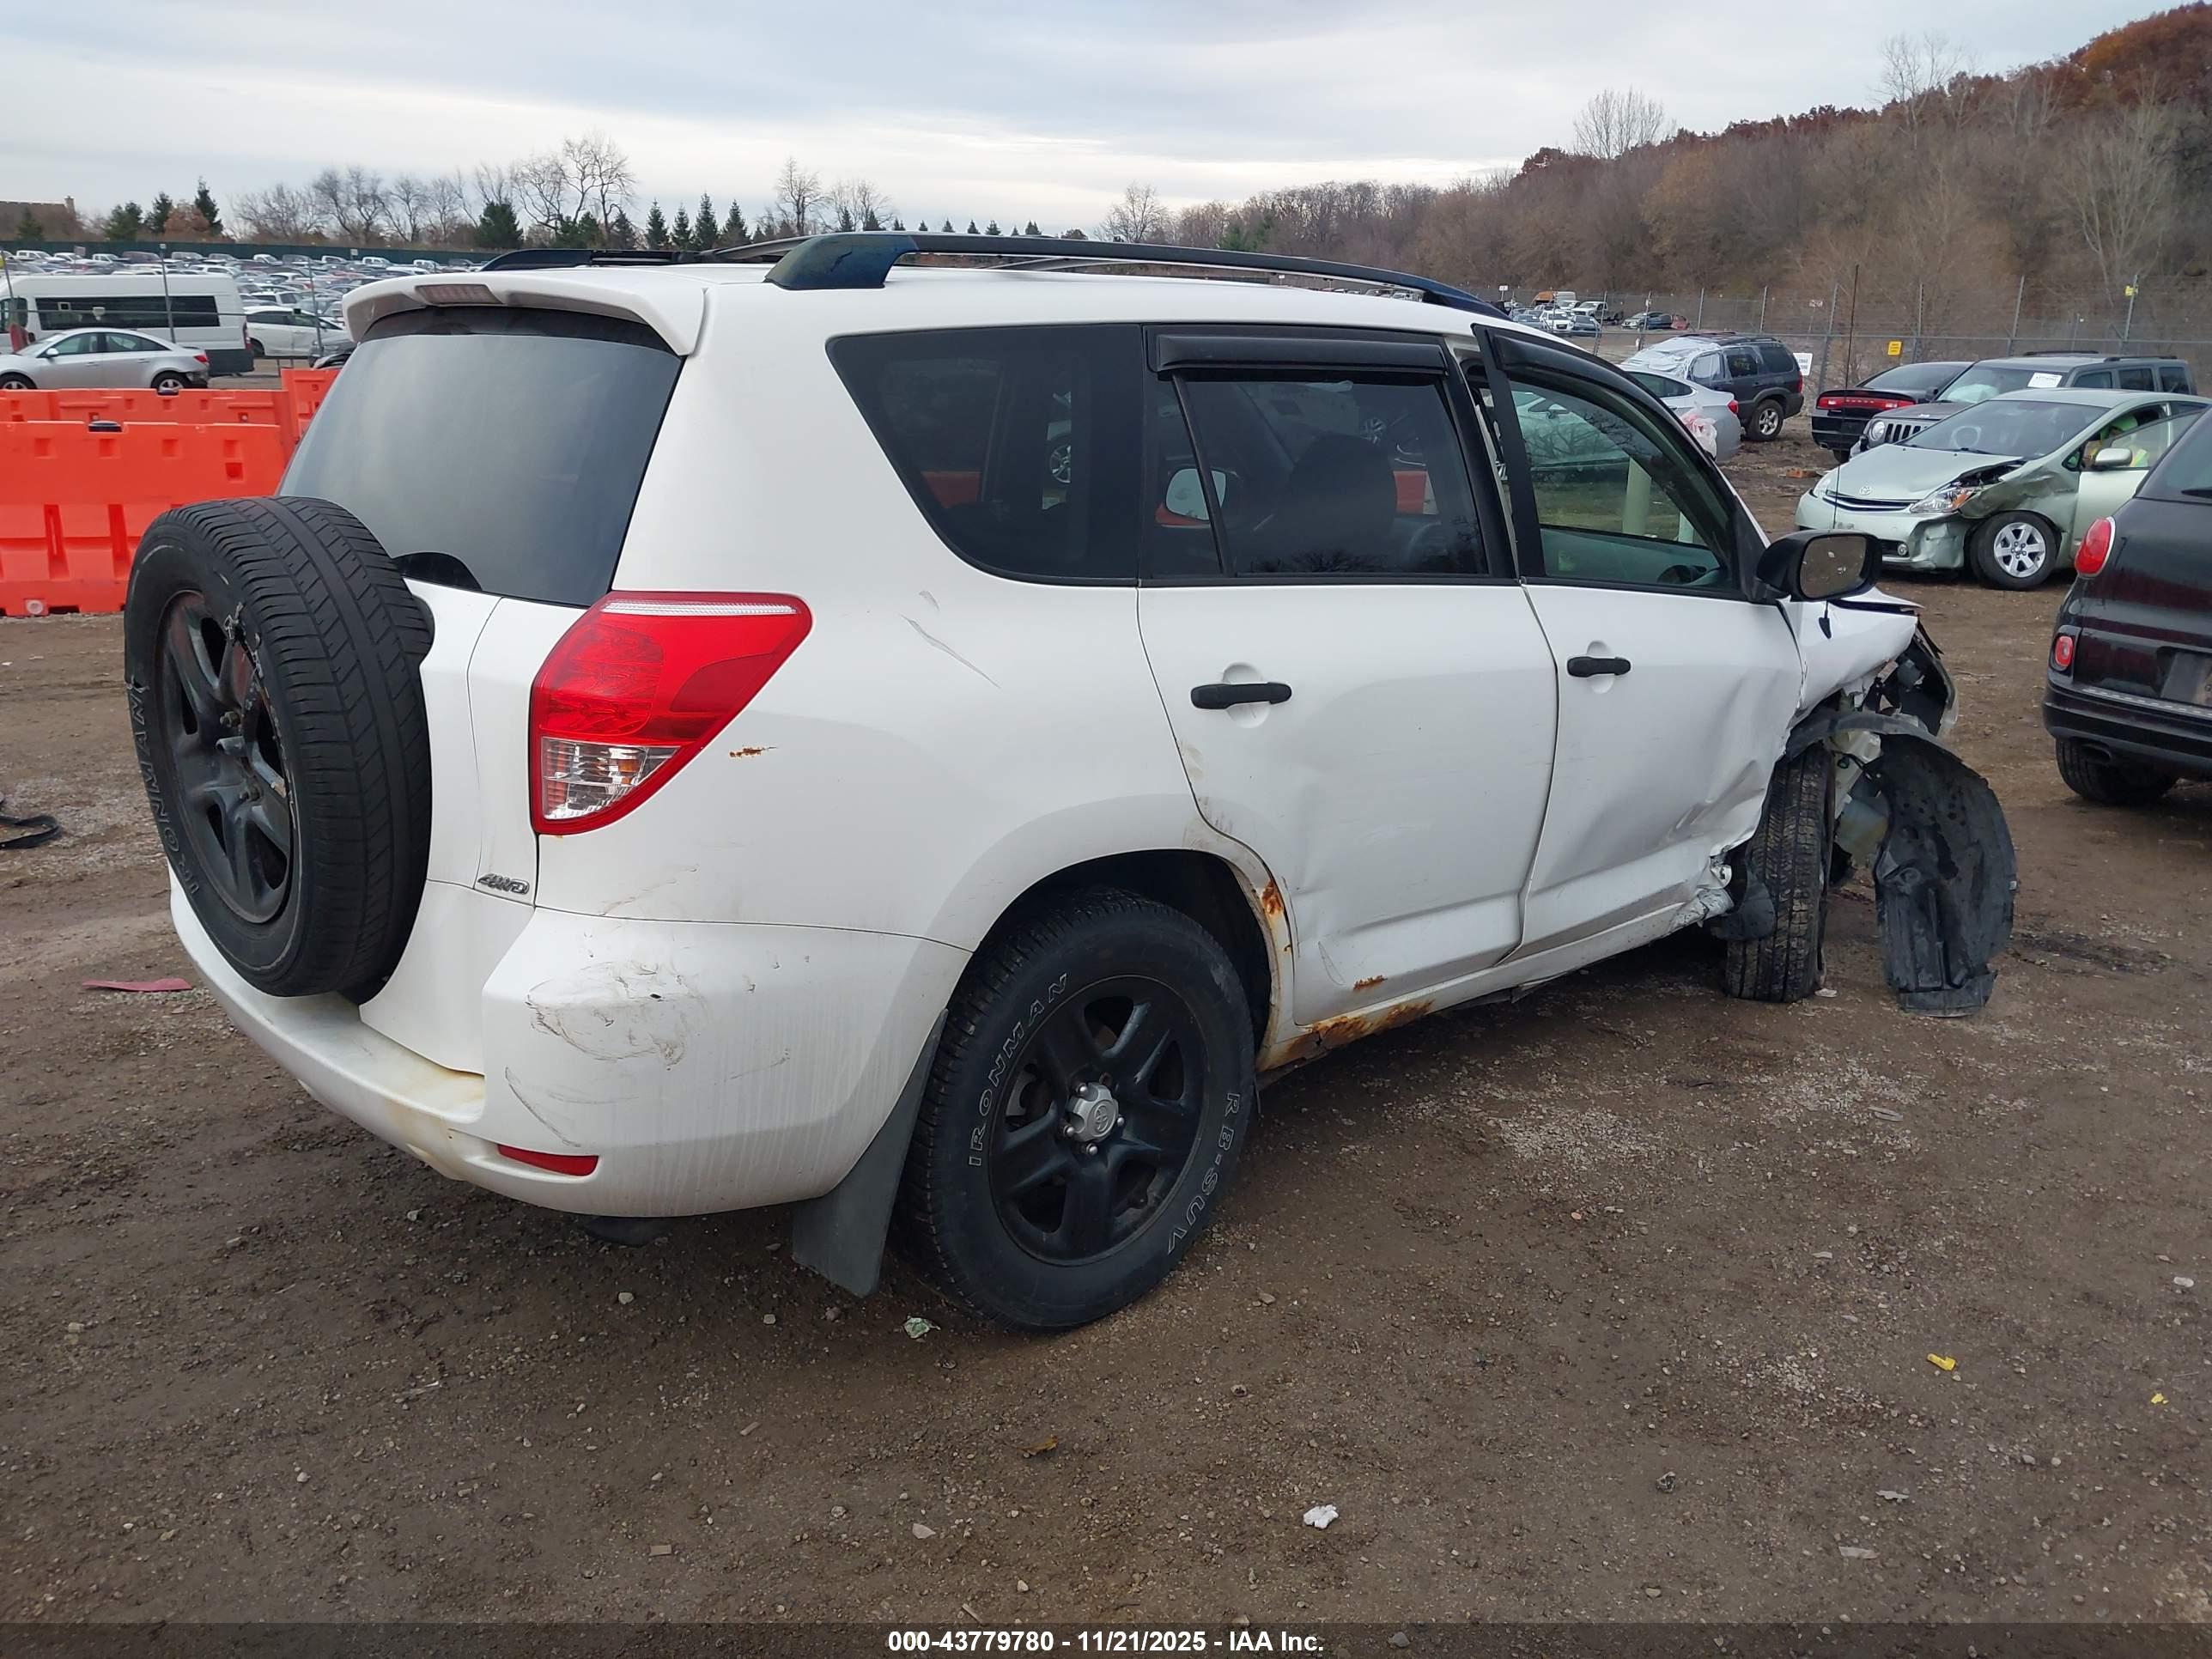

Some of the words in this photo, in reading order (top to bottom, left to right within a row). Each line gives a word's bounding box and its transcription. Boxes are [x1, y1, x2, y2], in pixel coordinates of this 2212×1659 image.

[128, 690, 200, 896] IRONMAN
[477, 873, 530, 895] 4WD
[969, 973, 1067, 1166] IRONMAN
